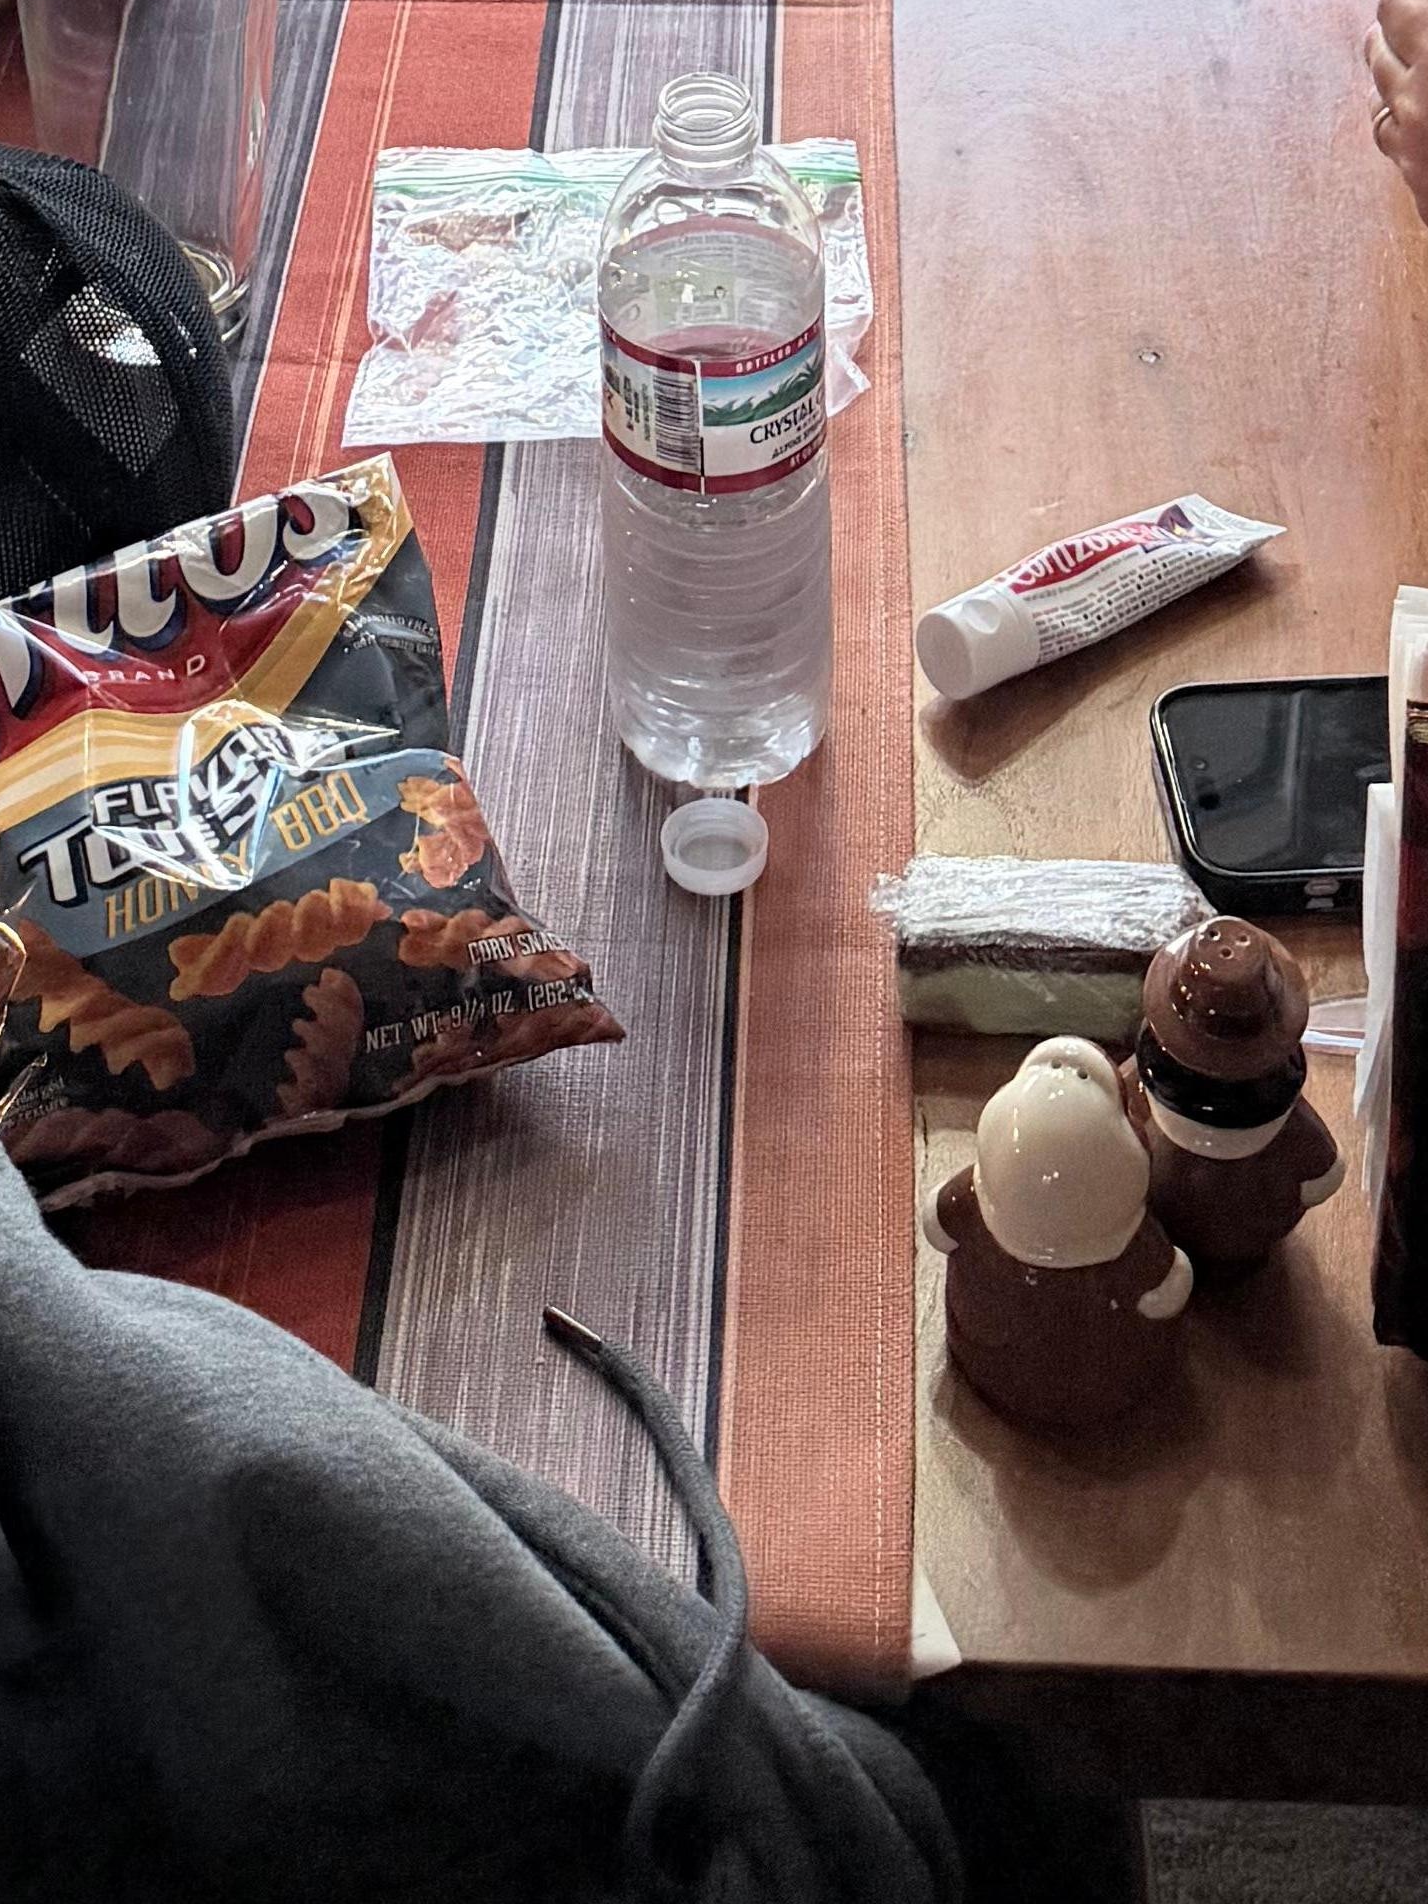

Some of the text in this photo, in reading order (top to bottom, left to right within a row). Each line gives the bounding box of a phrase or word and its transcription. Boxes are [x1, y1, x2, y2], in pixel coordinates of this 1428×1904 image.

[750, 397, 815, 444] CRYSTAL
[83, 654, 206, 682] BRAND
[104, 769, 372, 940] HONY BBQ
[467, 936, 515, 965] CORN
[365, 1022, 404, 1054] NET
[491, 990, 515, 1015] OZ
